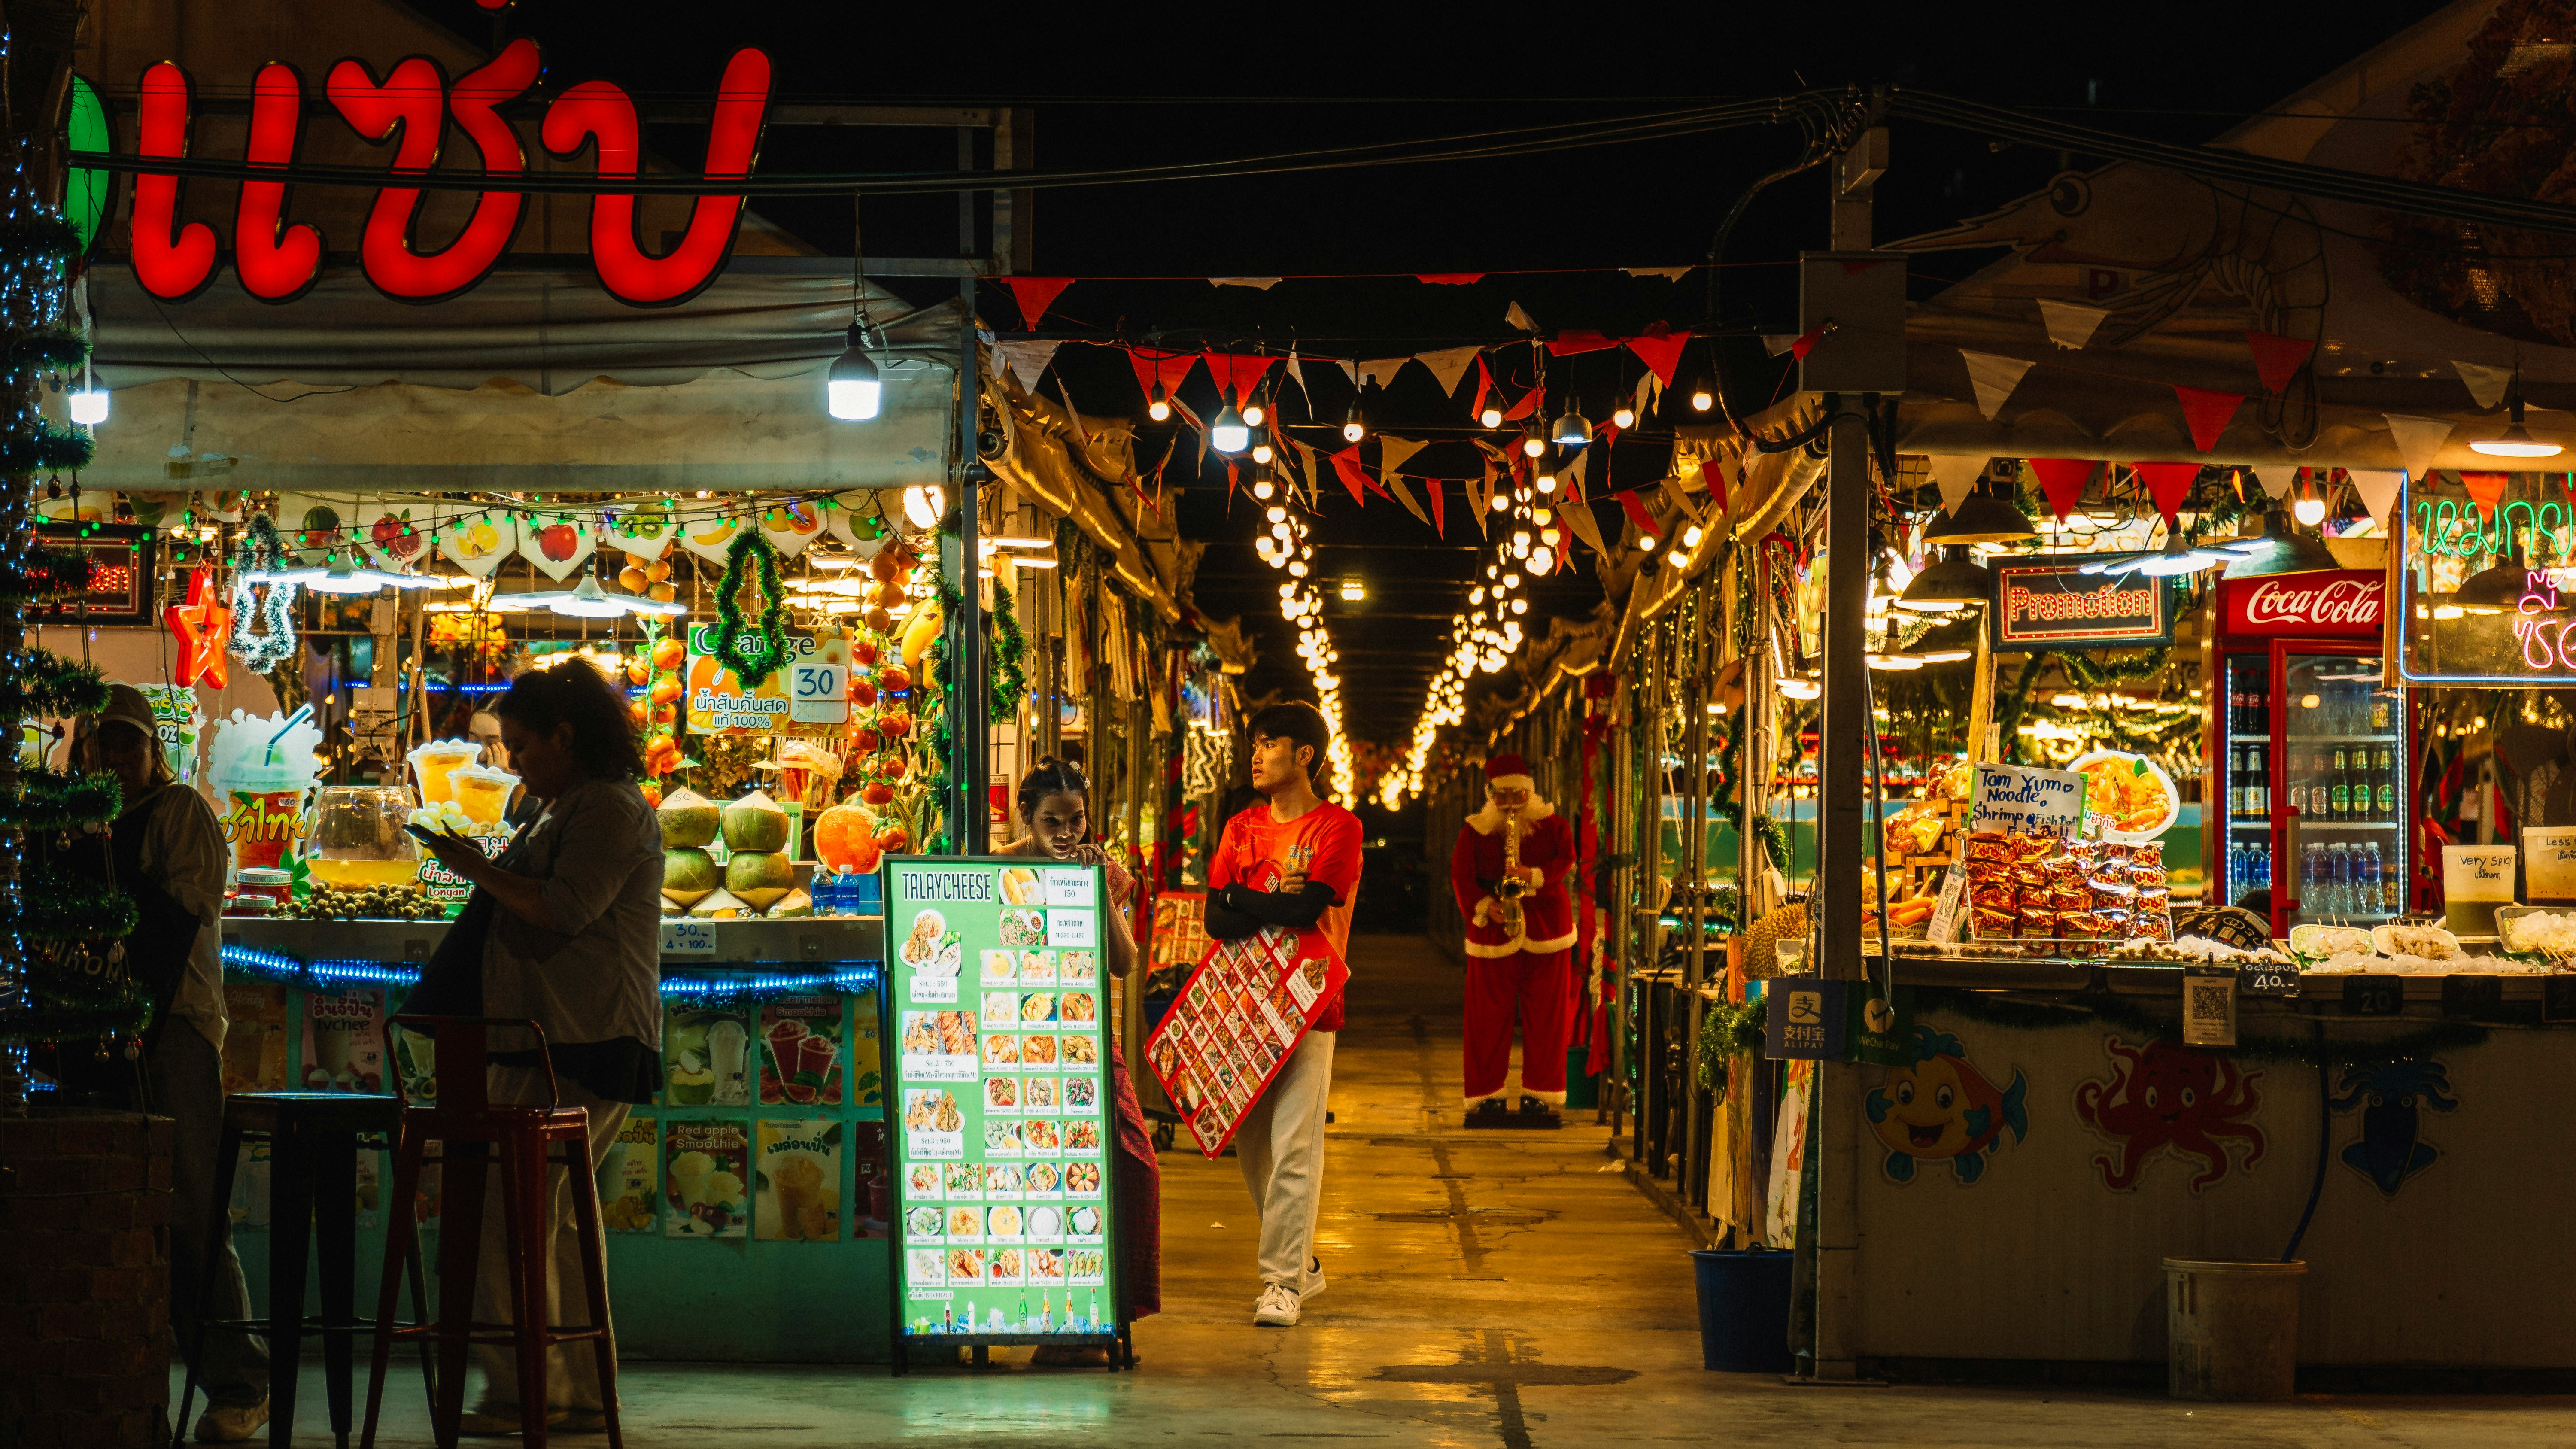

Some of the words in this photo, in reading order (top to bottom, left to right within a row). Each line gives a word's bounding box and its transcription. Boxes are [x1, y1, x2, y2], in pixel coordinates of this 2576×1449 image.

[130, 0, 775, 304] แซบ
[2011, 583, 2151, 621] Promotion
[2247, 580, 2386, 624] Coca-Cola
[797, 668, 834, 696] 30
[696, 690, 787, 713] น้ำส้มคั้นสด
[714, 714, 729, 726] แท้
[734, 716, 770, 727] 100%
[2021, 774, 2061, 792] Yum
[674, 793, 691, 802] 50
[219, 797, 317, 844] ชาไทย
[1973, 801, 2024, 826] Shrimp
[2036, 814, 2058, 826] Fish
[2060, 814, 2080, 827] Ball
[2546, 837, 2570, 846] Less
[2460, 855, 2487, 870] Very
[428, 887, 465, 899] Longan
[902, 873, 991, 900] TALAYCHEESE
[674, 923, 709, 937] 30.-
[2254, 974, 2295, 990] 40.-
[776, 995, 837, 1005] atermelon
[2360, 990, 2390, 1013] 20
[775, 1005, 827, 1017] Smoothie
[316, 1019, 370, 1031] lychee
[865, 1030, 875, 1039] 60
[1783, 1027, 1825, 1042] 支付宝
[1886, 1040, 1900, 1052] Pay
[677, 1125, 700, 1135] Red
[705, 1125, 739, 1137] apple
[676, 1139, 740, 1149] Smoothie
[861, 1163, 871, 1173] 70
